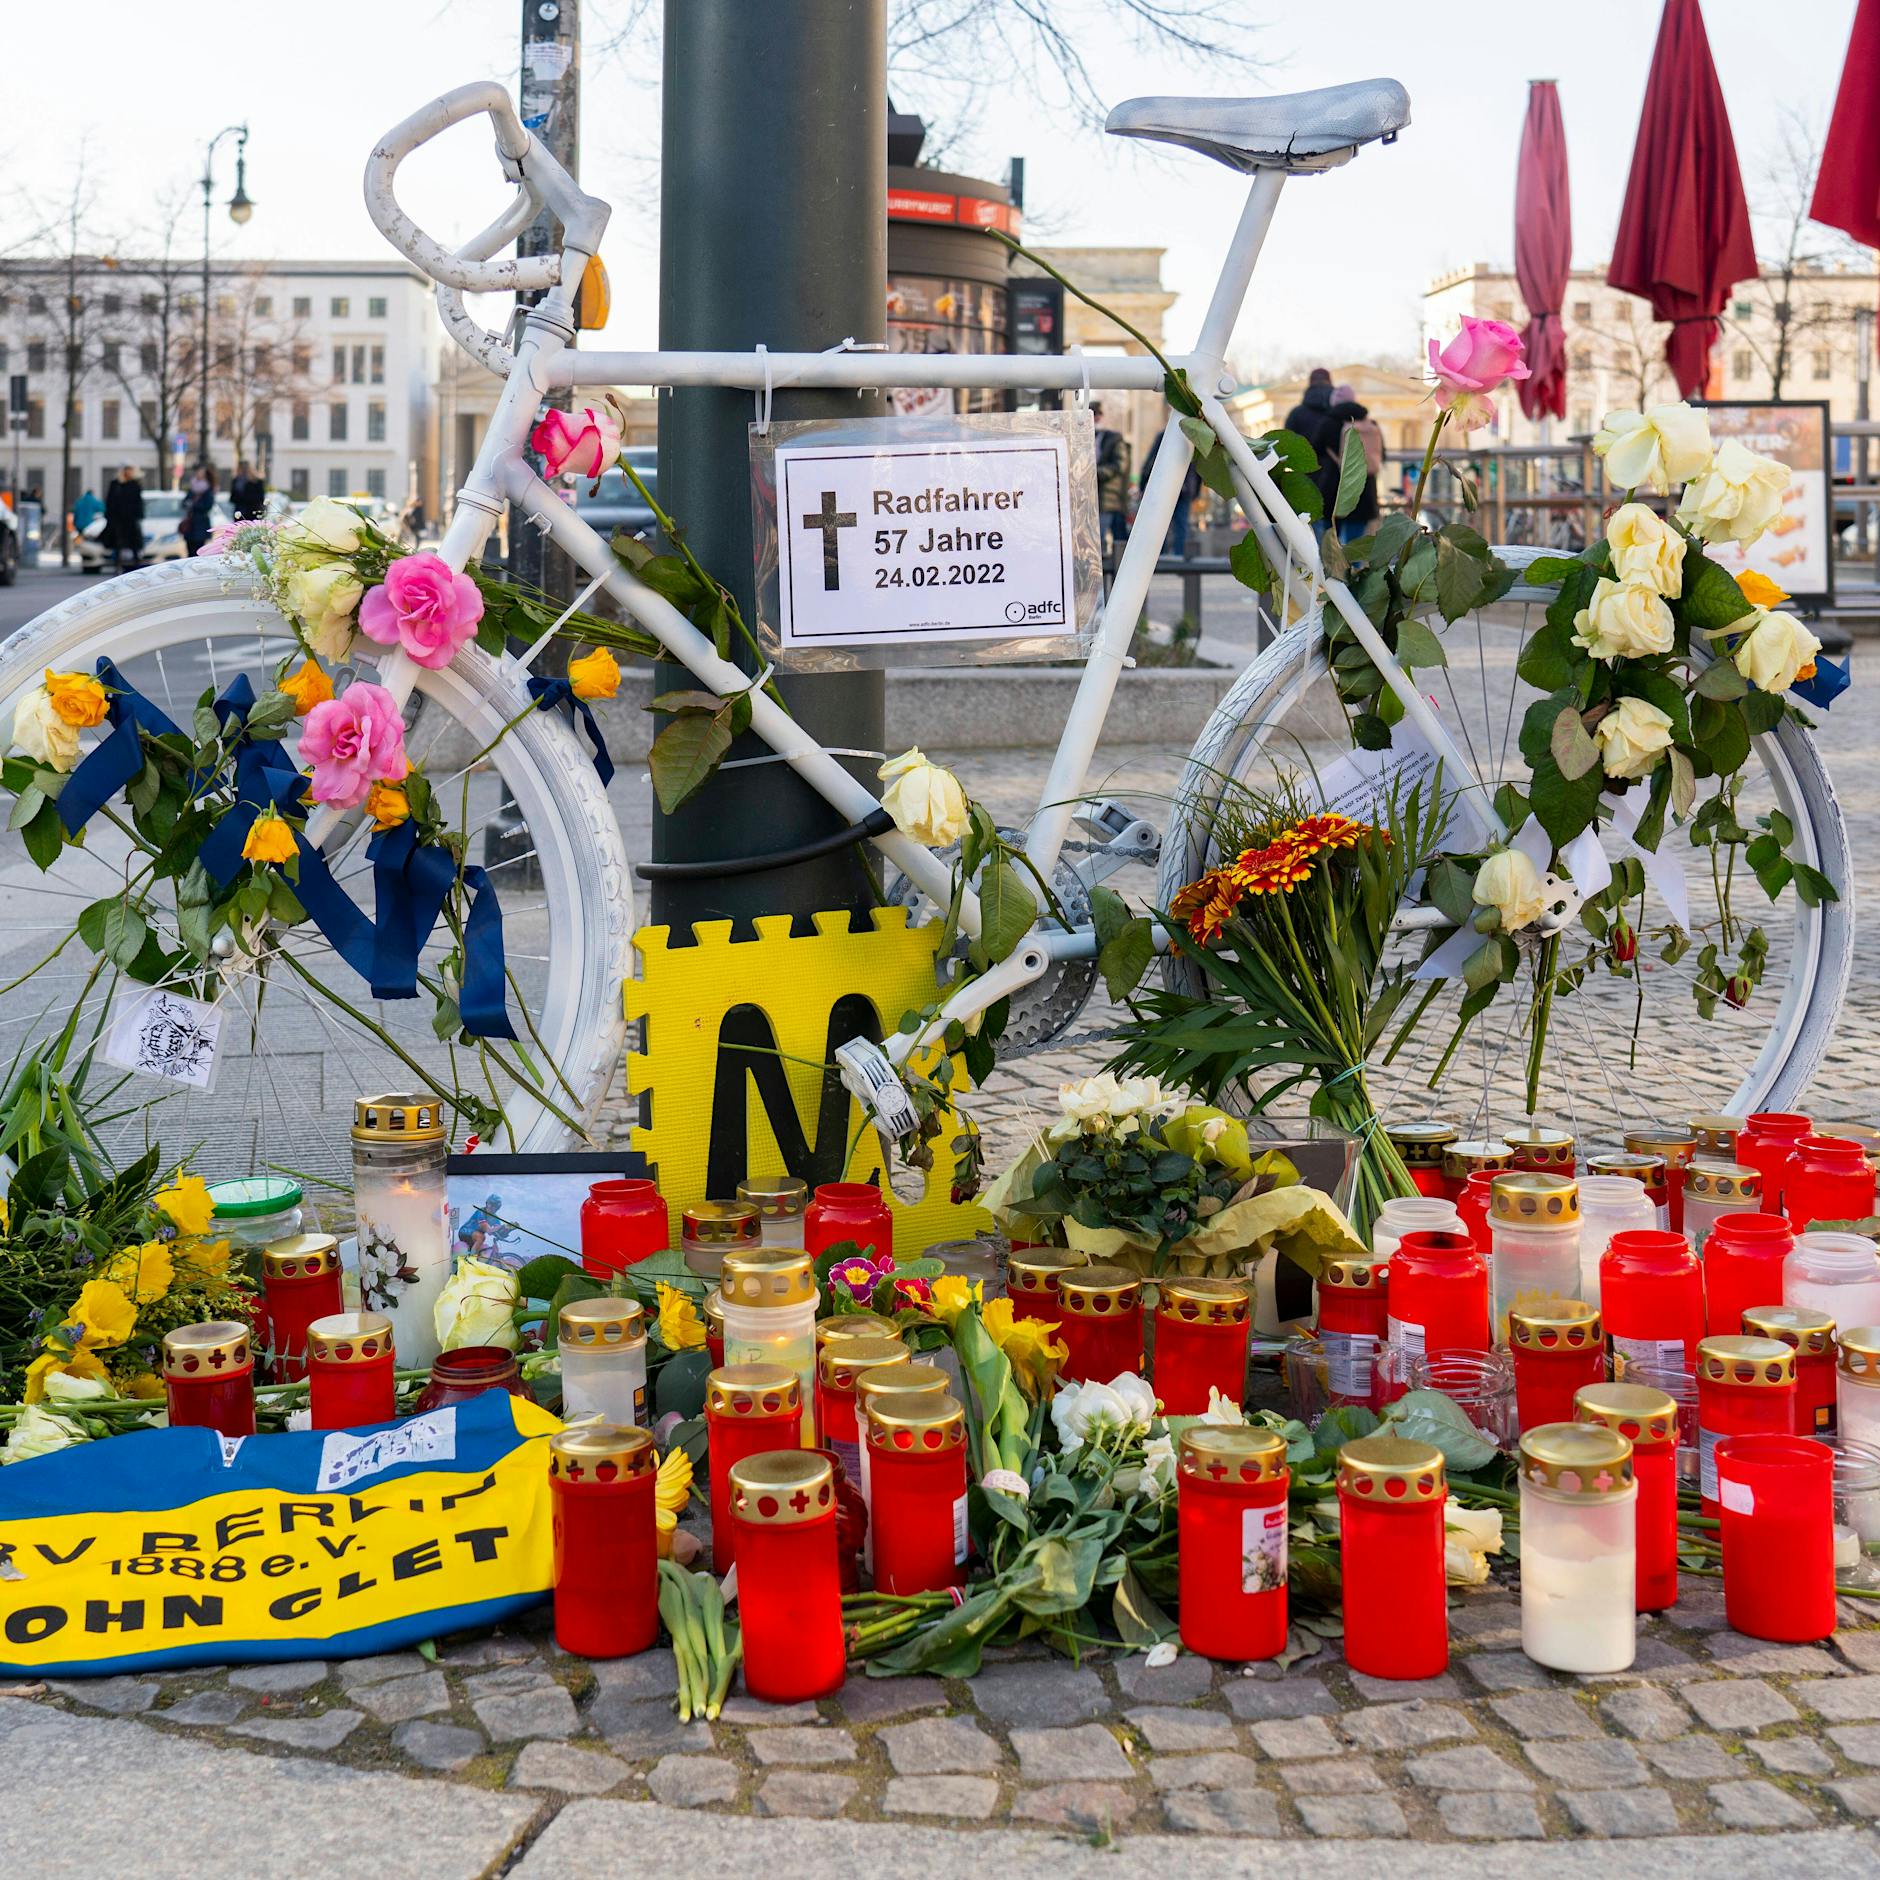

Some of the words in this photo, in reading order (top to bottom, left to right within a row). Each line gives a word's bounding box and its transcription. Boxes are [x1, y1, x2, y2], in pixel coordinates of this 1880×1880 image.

[888, 197, 952, 215] URRYWURST
[872, 487, 1024, 515] Radfahrer
[874, 529, 908, 555] 57
[918, 527, 1004, 553] Jahre
[875, 563, 1005, 589] 24.02.2022
[1028, 600, 1061, 614] adfc
[1391, 750, 1416, 769] schönen
[1355, 791, 1369, 803] zwei
[1389, 760, 1420, 783] zummen
[1419, 751, 1430, 762] mit
[110, 1555, 247, 1583] 1888
[268, 1526, 509, 1621] GLET
